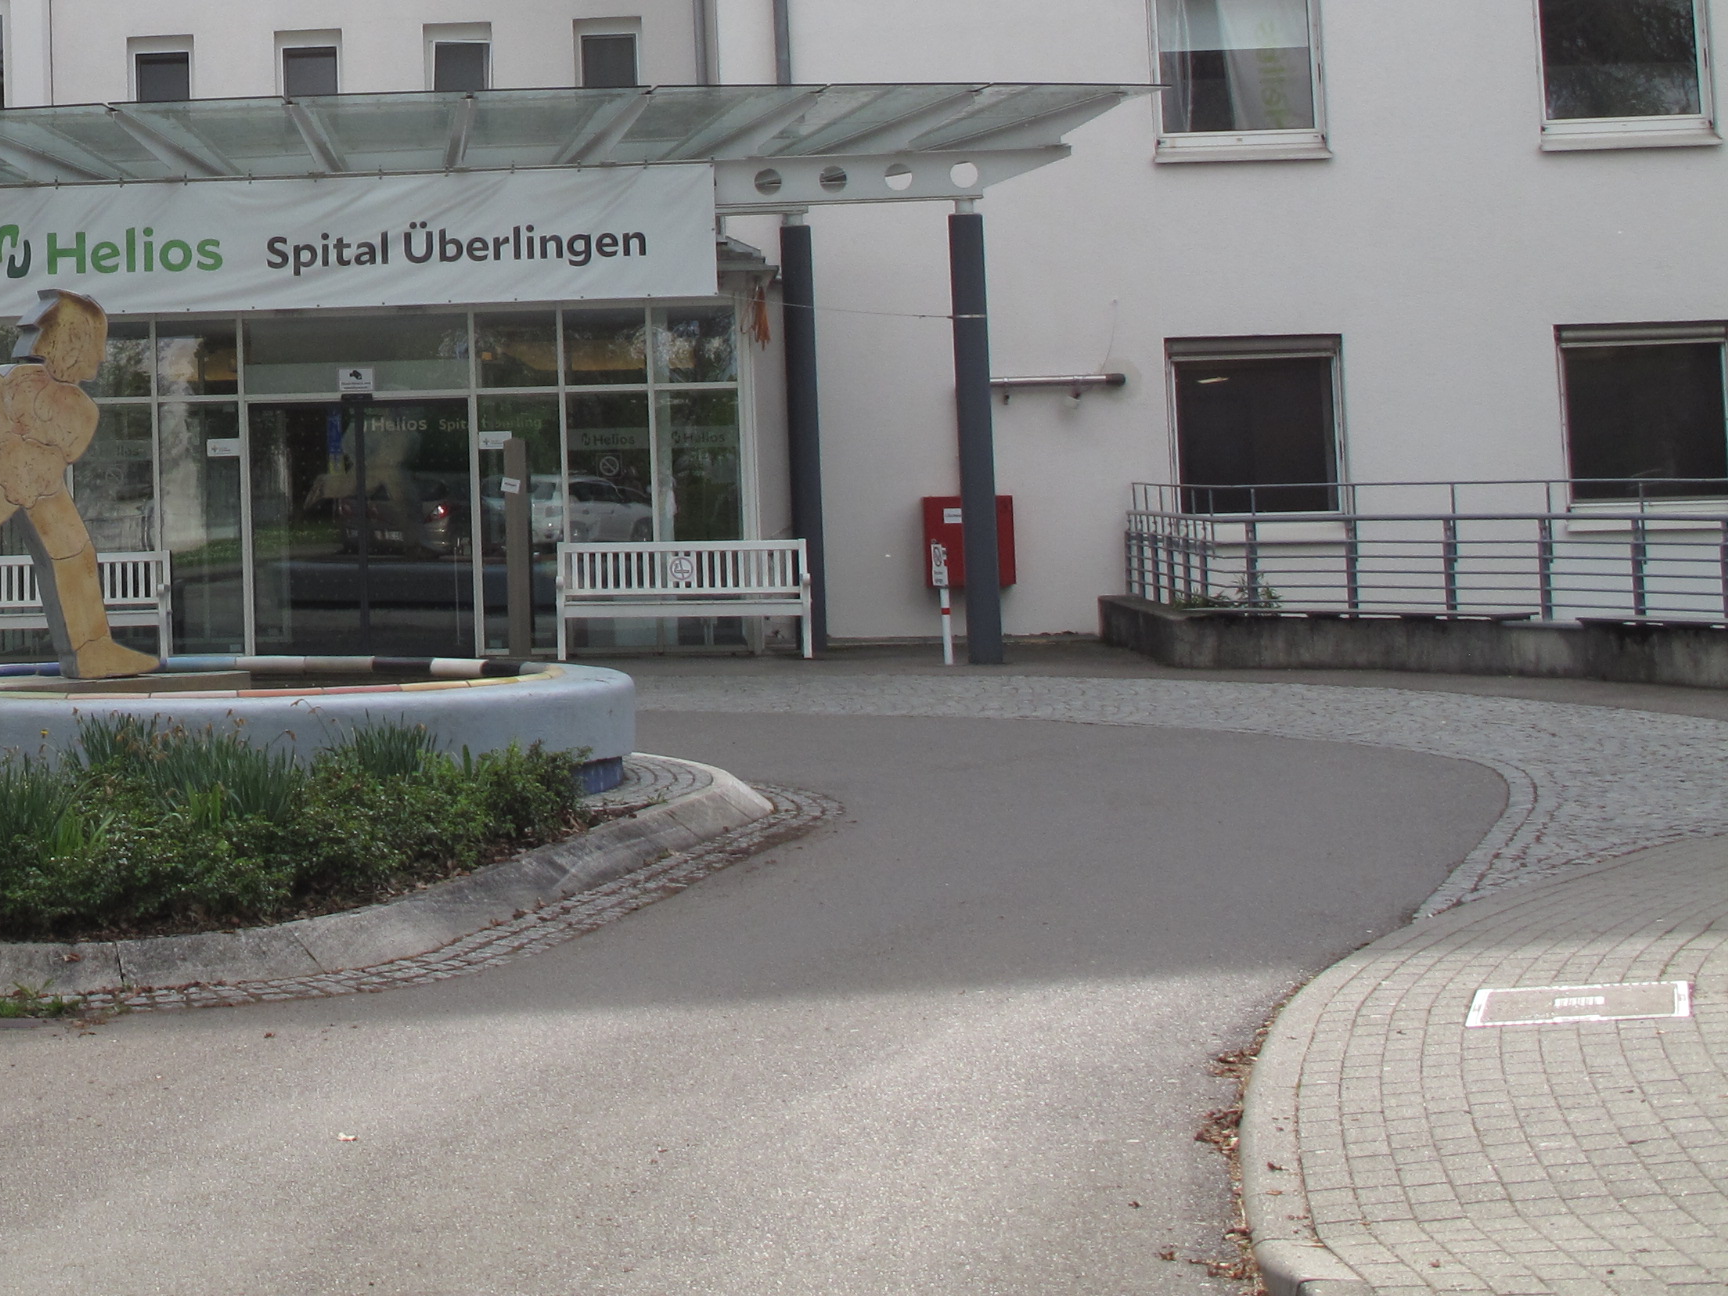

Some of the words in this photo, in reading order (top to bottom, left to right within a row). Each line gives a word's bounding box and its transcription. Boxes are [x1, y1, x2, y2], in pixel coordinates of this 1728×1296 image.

[46, 226, 224, 275] Helios
[266, 230, 390, 277] Spital
[404, 221, 646, 266] Überlingen
[593, 434, 636, 447] Helios
